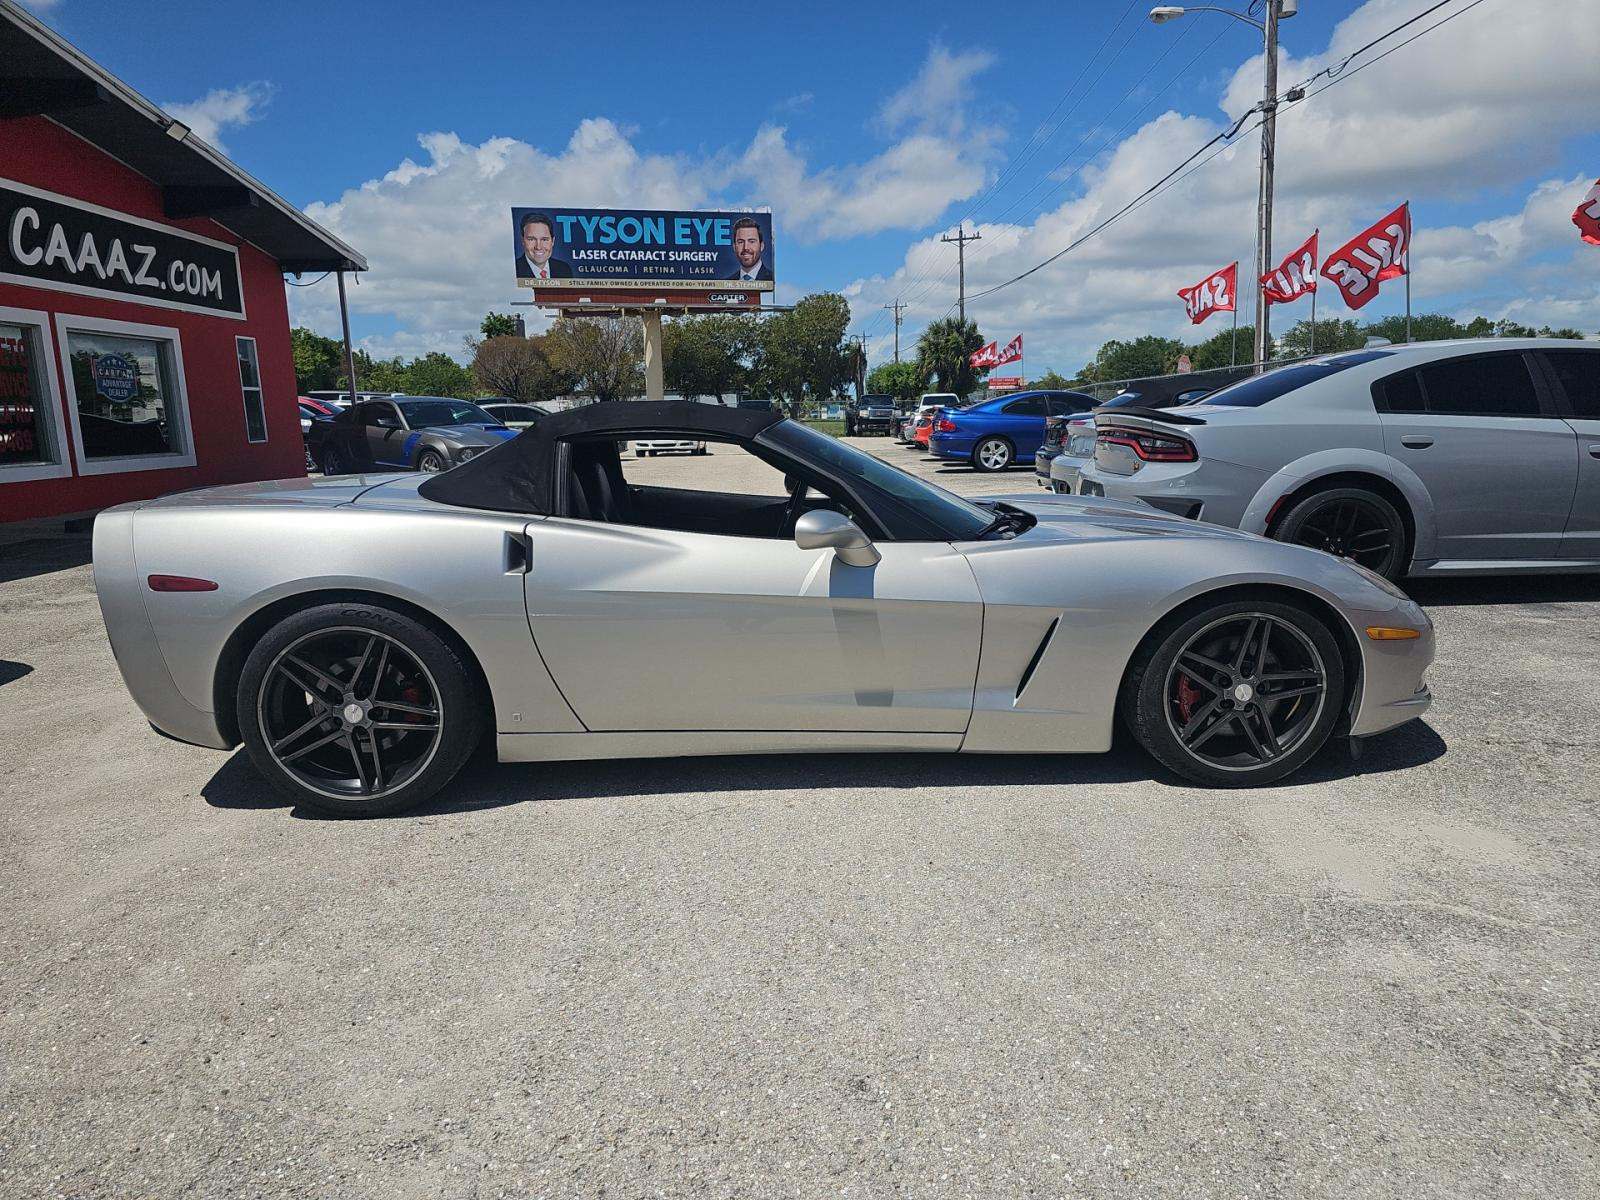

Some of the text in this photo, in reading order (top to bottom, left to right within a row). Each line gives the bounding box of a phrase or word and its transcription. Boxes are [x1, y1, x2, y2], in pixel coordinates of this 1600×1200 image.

[556, 216, 731, 245] TYSON EYE
[9, 206, 223, 301] CAAAZ.COM
[572, 249, 719, 263] LASER CATARACT SURGERY
[577, 265, 715, 275] GLAUCOMA RETINA LASIK
[538, 279, 561, 287] TYSON
[586, 280, 608, 288] FAMILY
[610, 280, 633, 288] OWNED
[640, 280, 671, 288] OPERATED
[672, 280, 684, 288] FOR
[711, 293, 746, 302] CARTER
